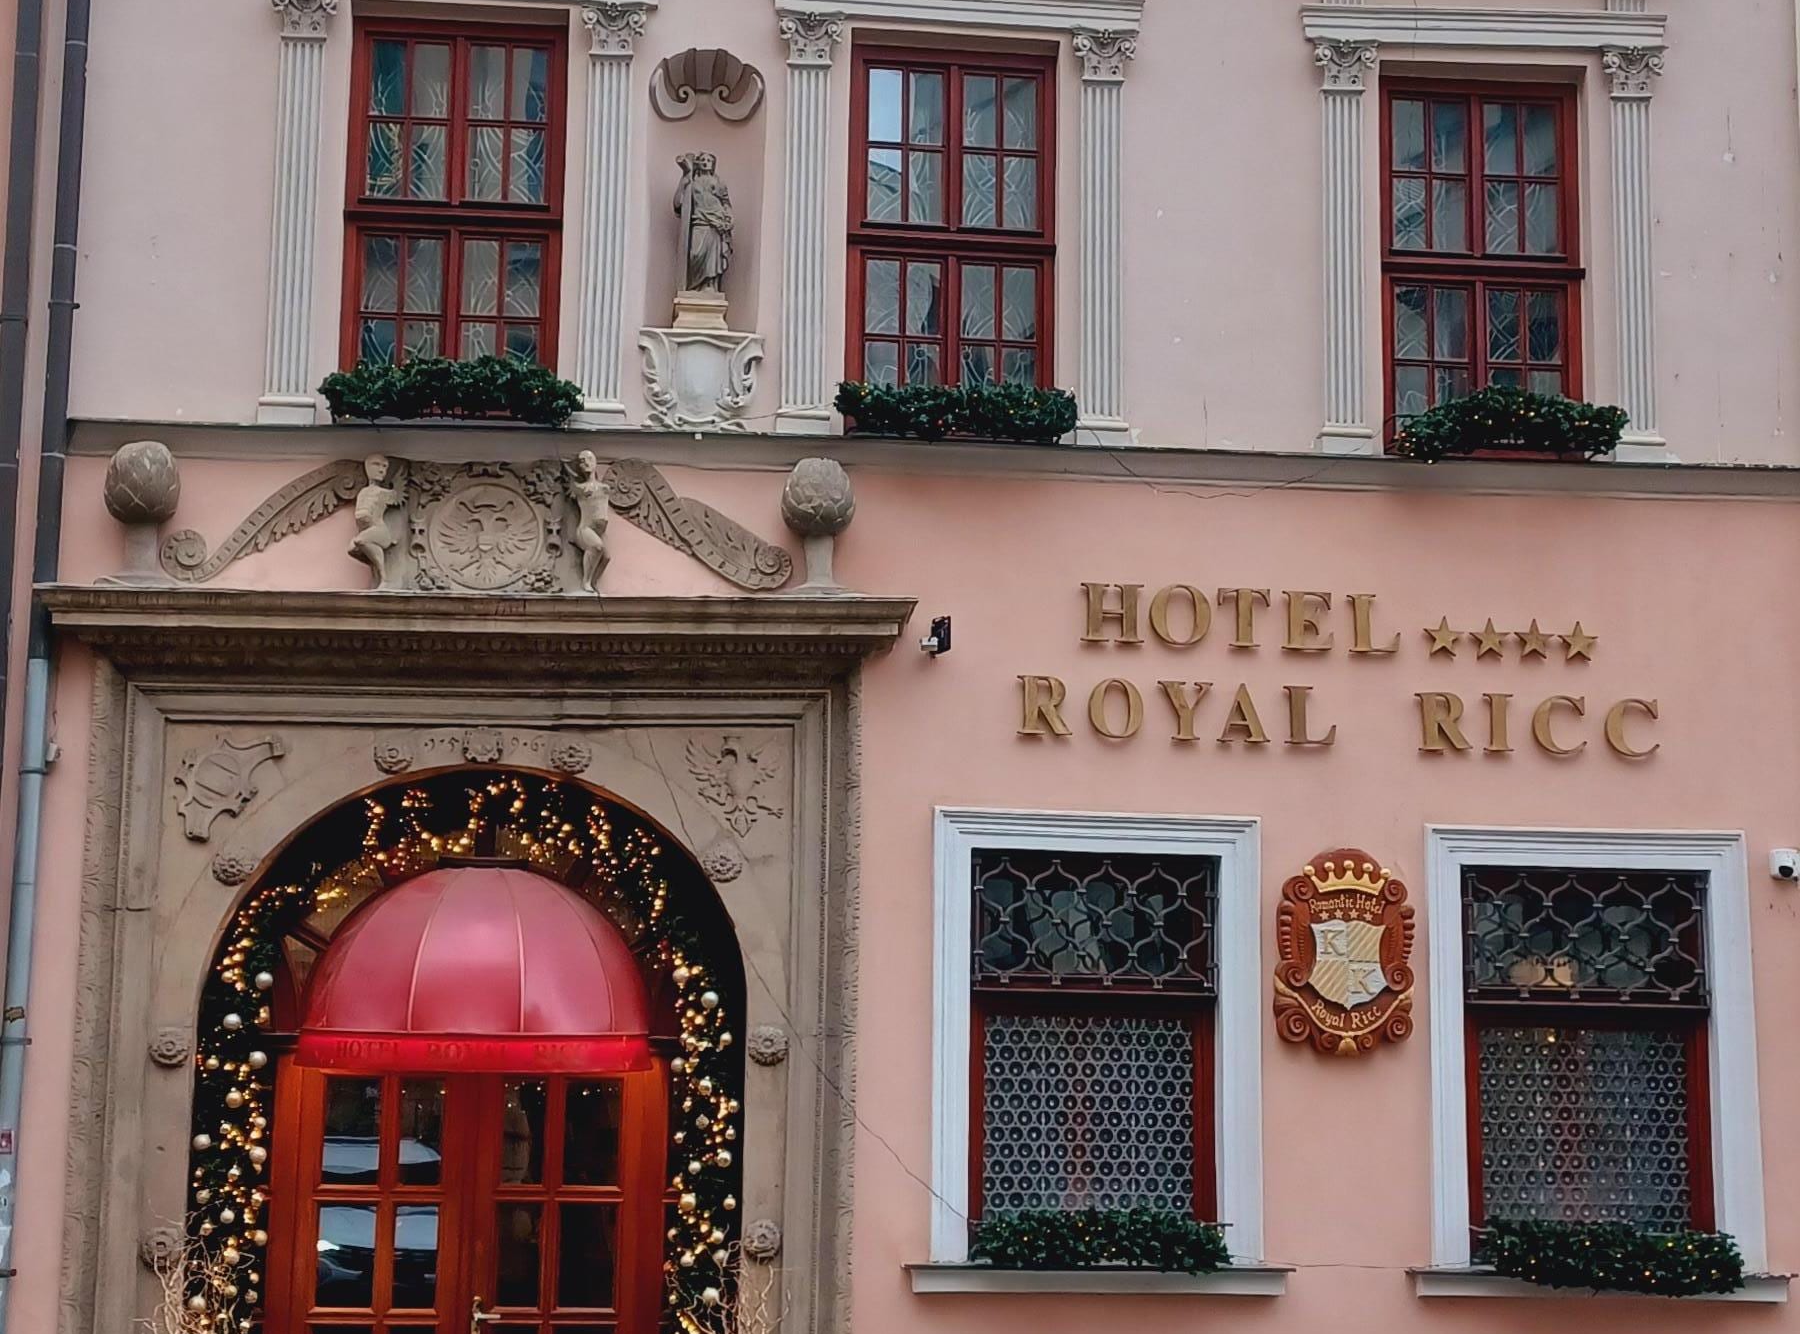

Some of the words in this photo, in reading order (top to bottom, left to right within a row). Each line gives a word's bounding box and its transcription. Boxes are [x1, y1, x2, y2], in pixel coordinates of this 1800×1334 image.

[1080, 582, 1401, 654] HOTEL
[1016, 674, 1337, 746] ROYAL
[1413, 692, 1661, 759] RICC
[1308, 894, 1354, 913] Romantic
[1355, 893, 1386, 914] Hotel
[1320, 929, 1346, 957] K
[1350, 967, 1377, 996] K
[1311, 999, 1345, 1029] Royal
[1351, 1006, 1382, 1029] Ricc
